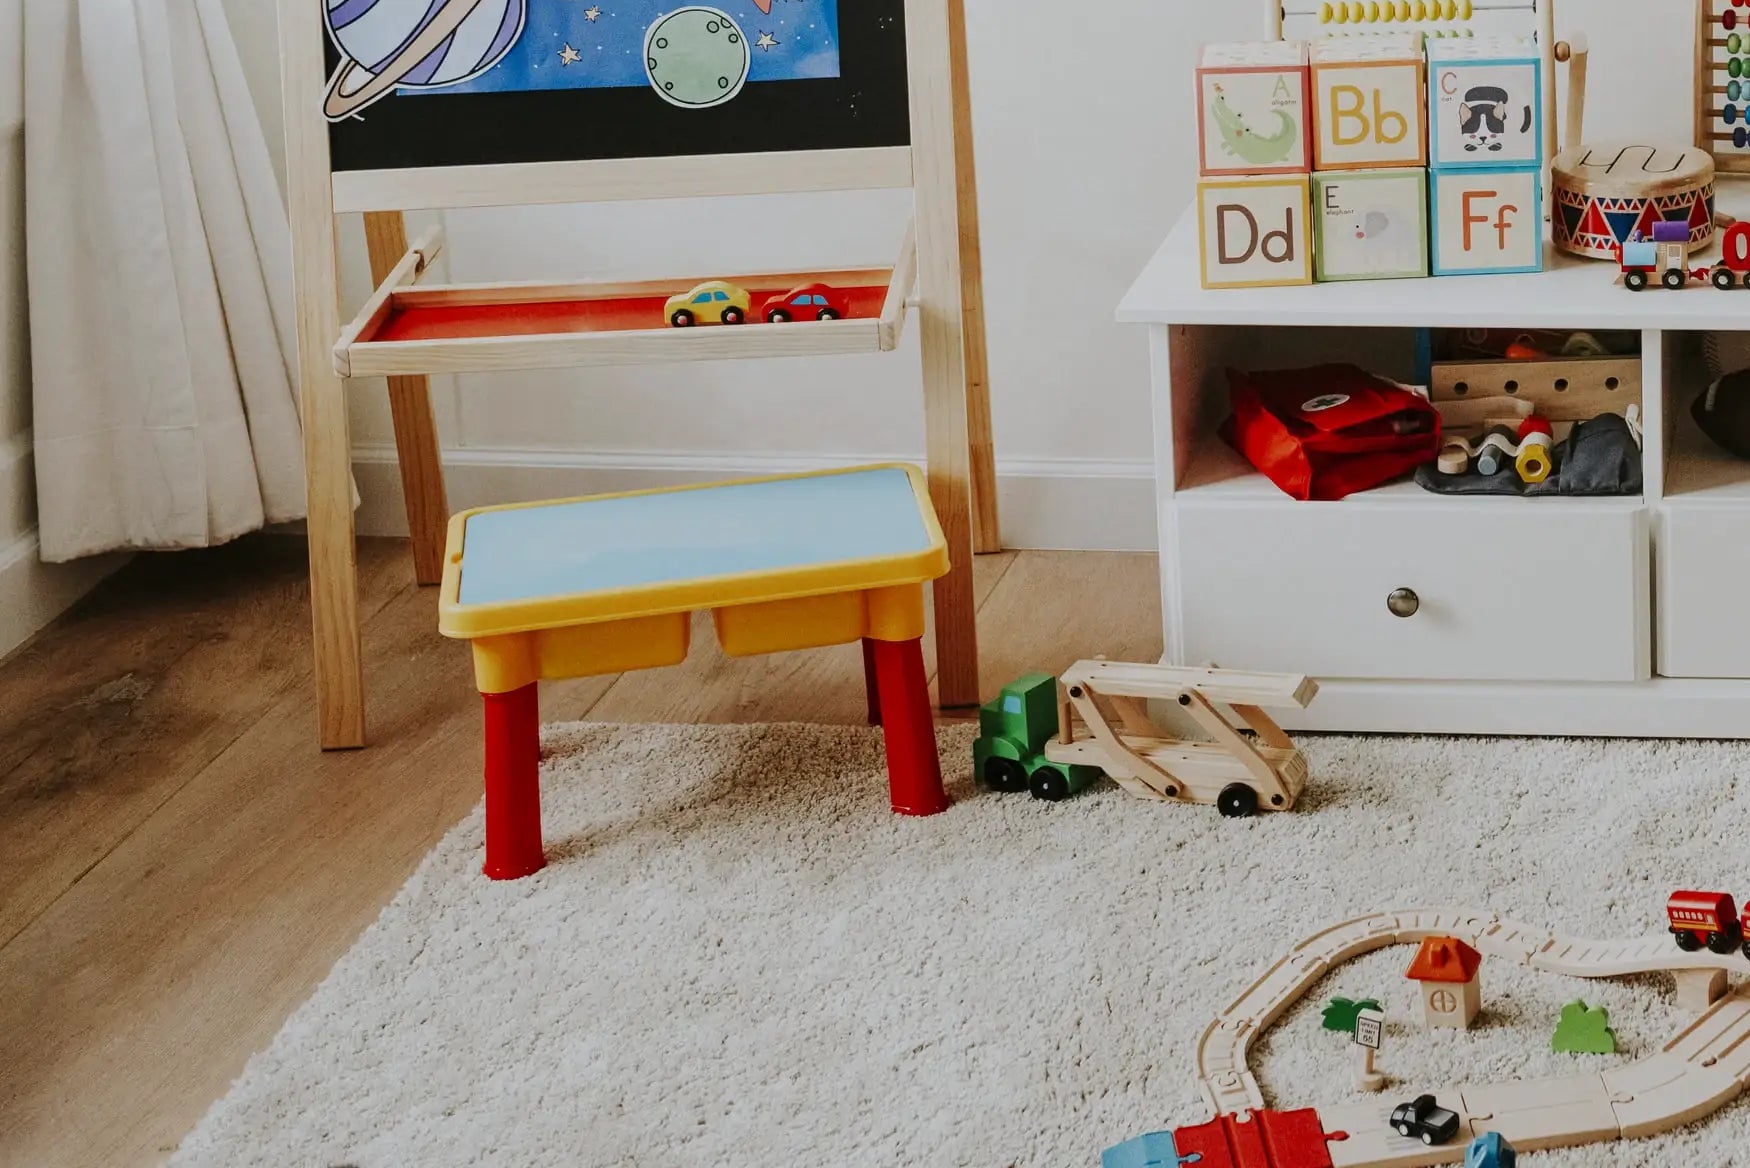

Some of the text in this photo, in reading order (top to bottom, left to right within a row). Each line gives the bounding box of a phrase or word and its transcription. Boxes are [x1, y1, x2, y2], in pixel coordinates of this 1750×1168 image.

[1272, 74, 1291, 98] A
[1441, 71, 1457, 95] C
[1330, 84, 1408, 147] Bb
[1325, 185, 1340, 209] E
[1217, 203, 1295, 266] Dd
[1461, 190, 1518, 252] Ff
